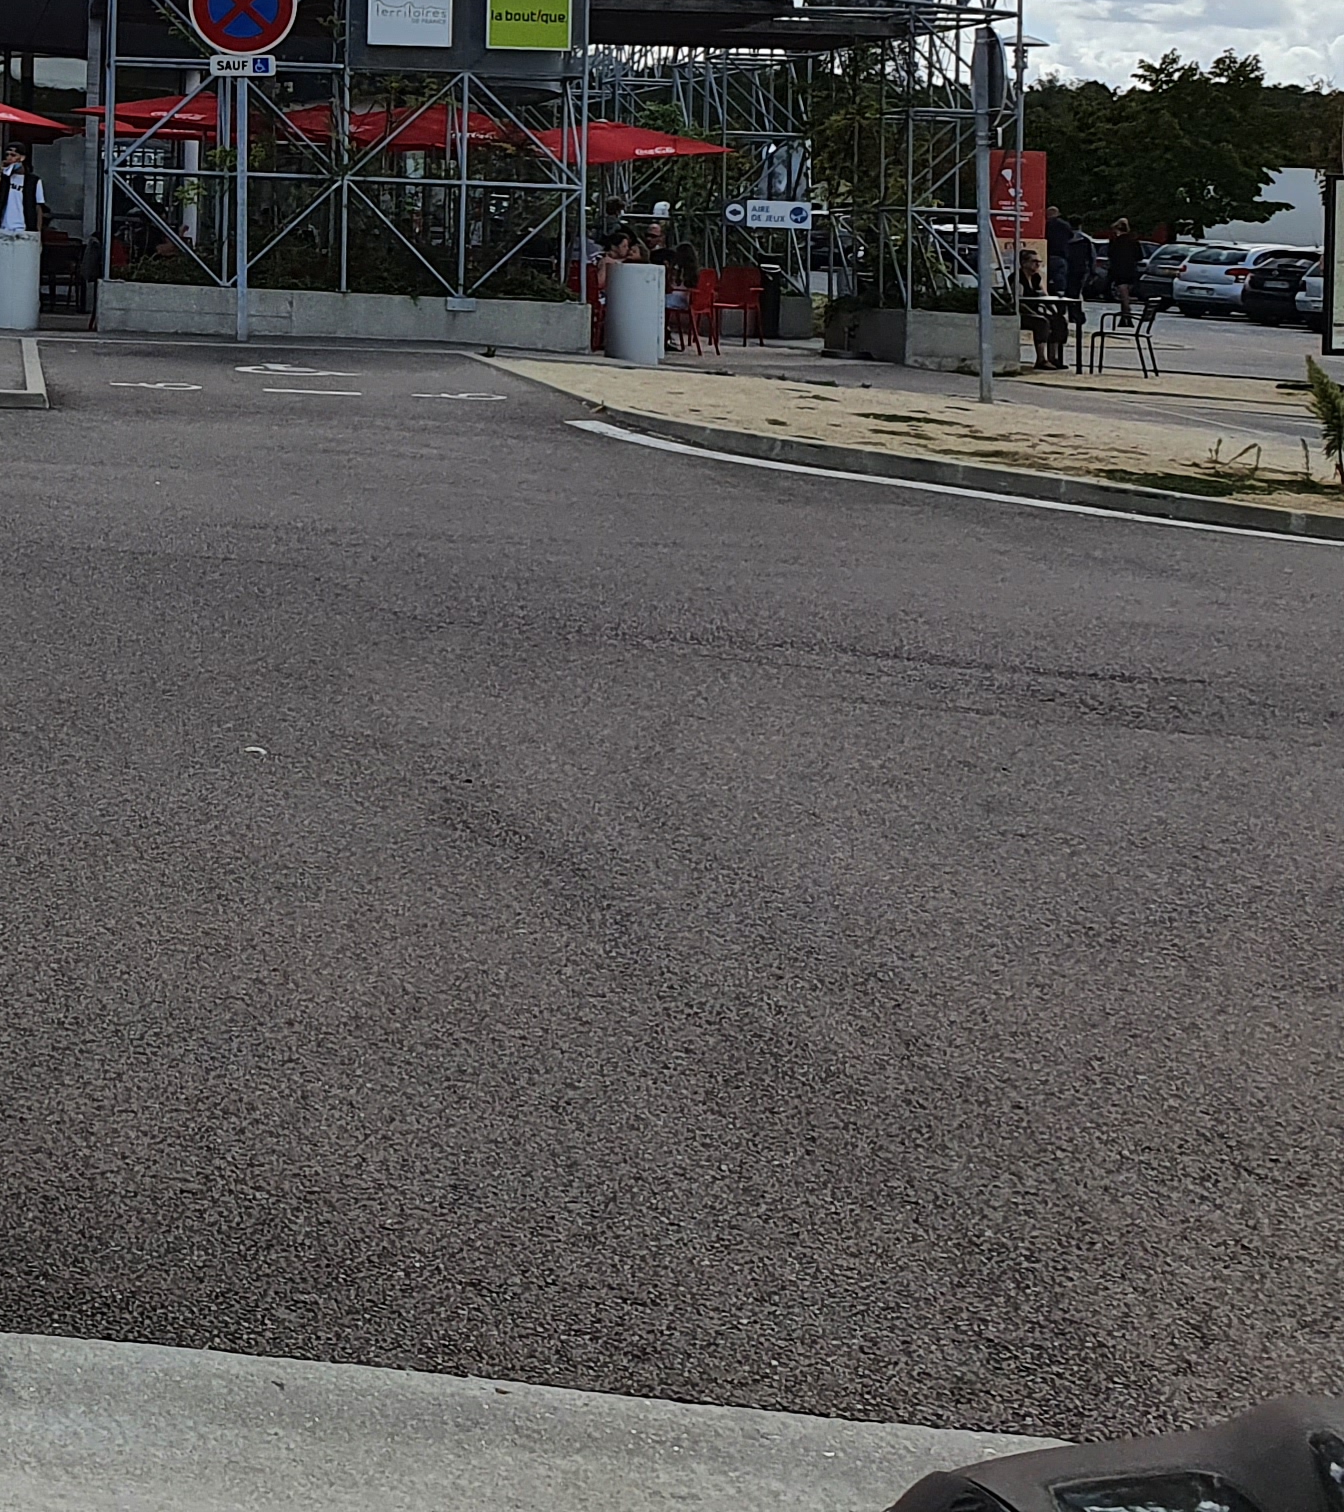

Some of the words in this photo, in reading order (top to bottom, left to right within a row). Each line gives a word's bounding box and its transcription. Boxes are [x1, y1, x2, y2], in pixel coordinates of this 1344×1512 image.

[216, 60, 249, 71] SAUF
[751, 205, 770, 213] AIRE
[751, 214, 762, 222] DE
[765, 215, 786, 223] JEUX
